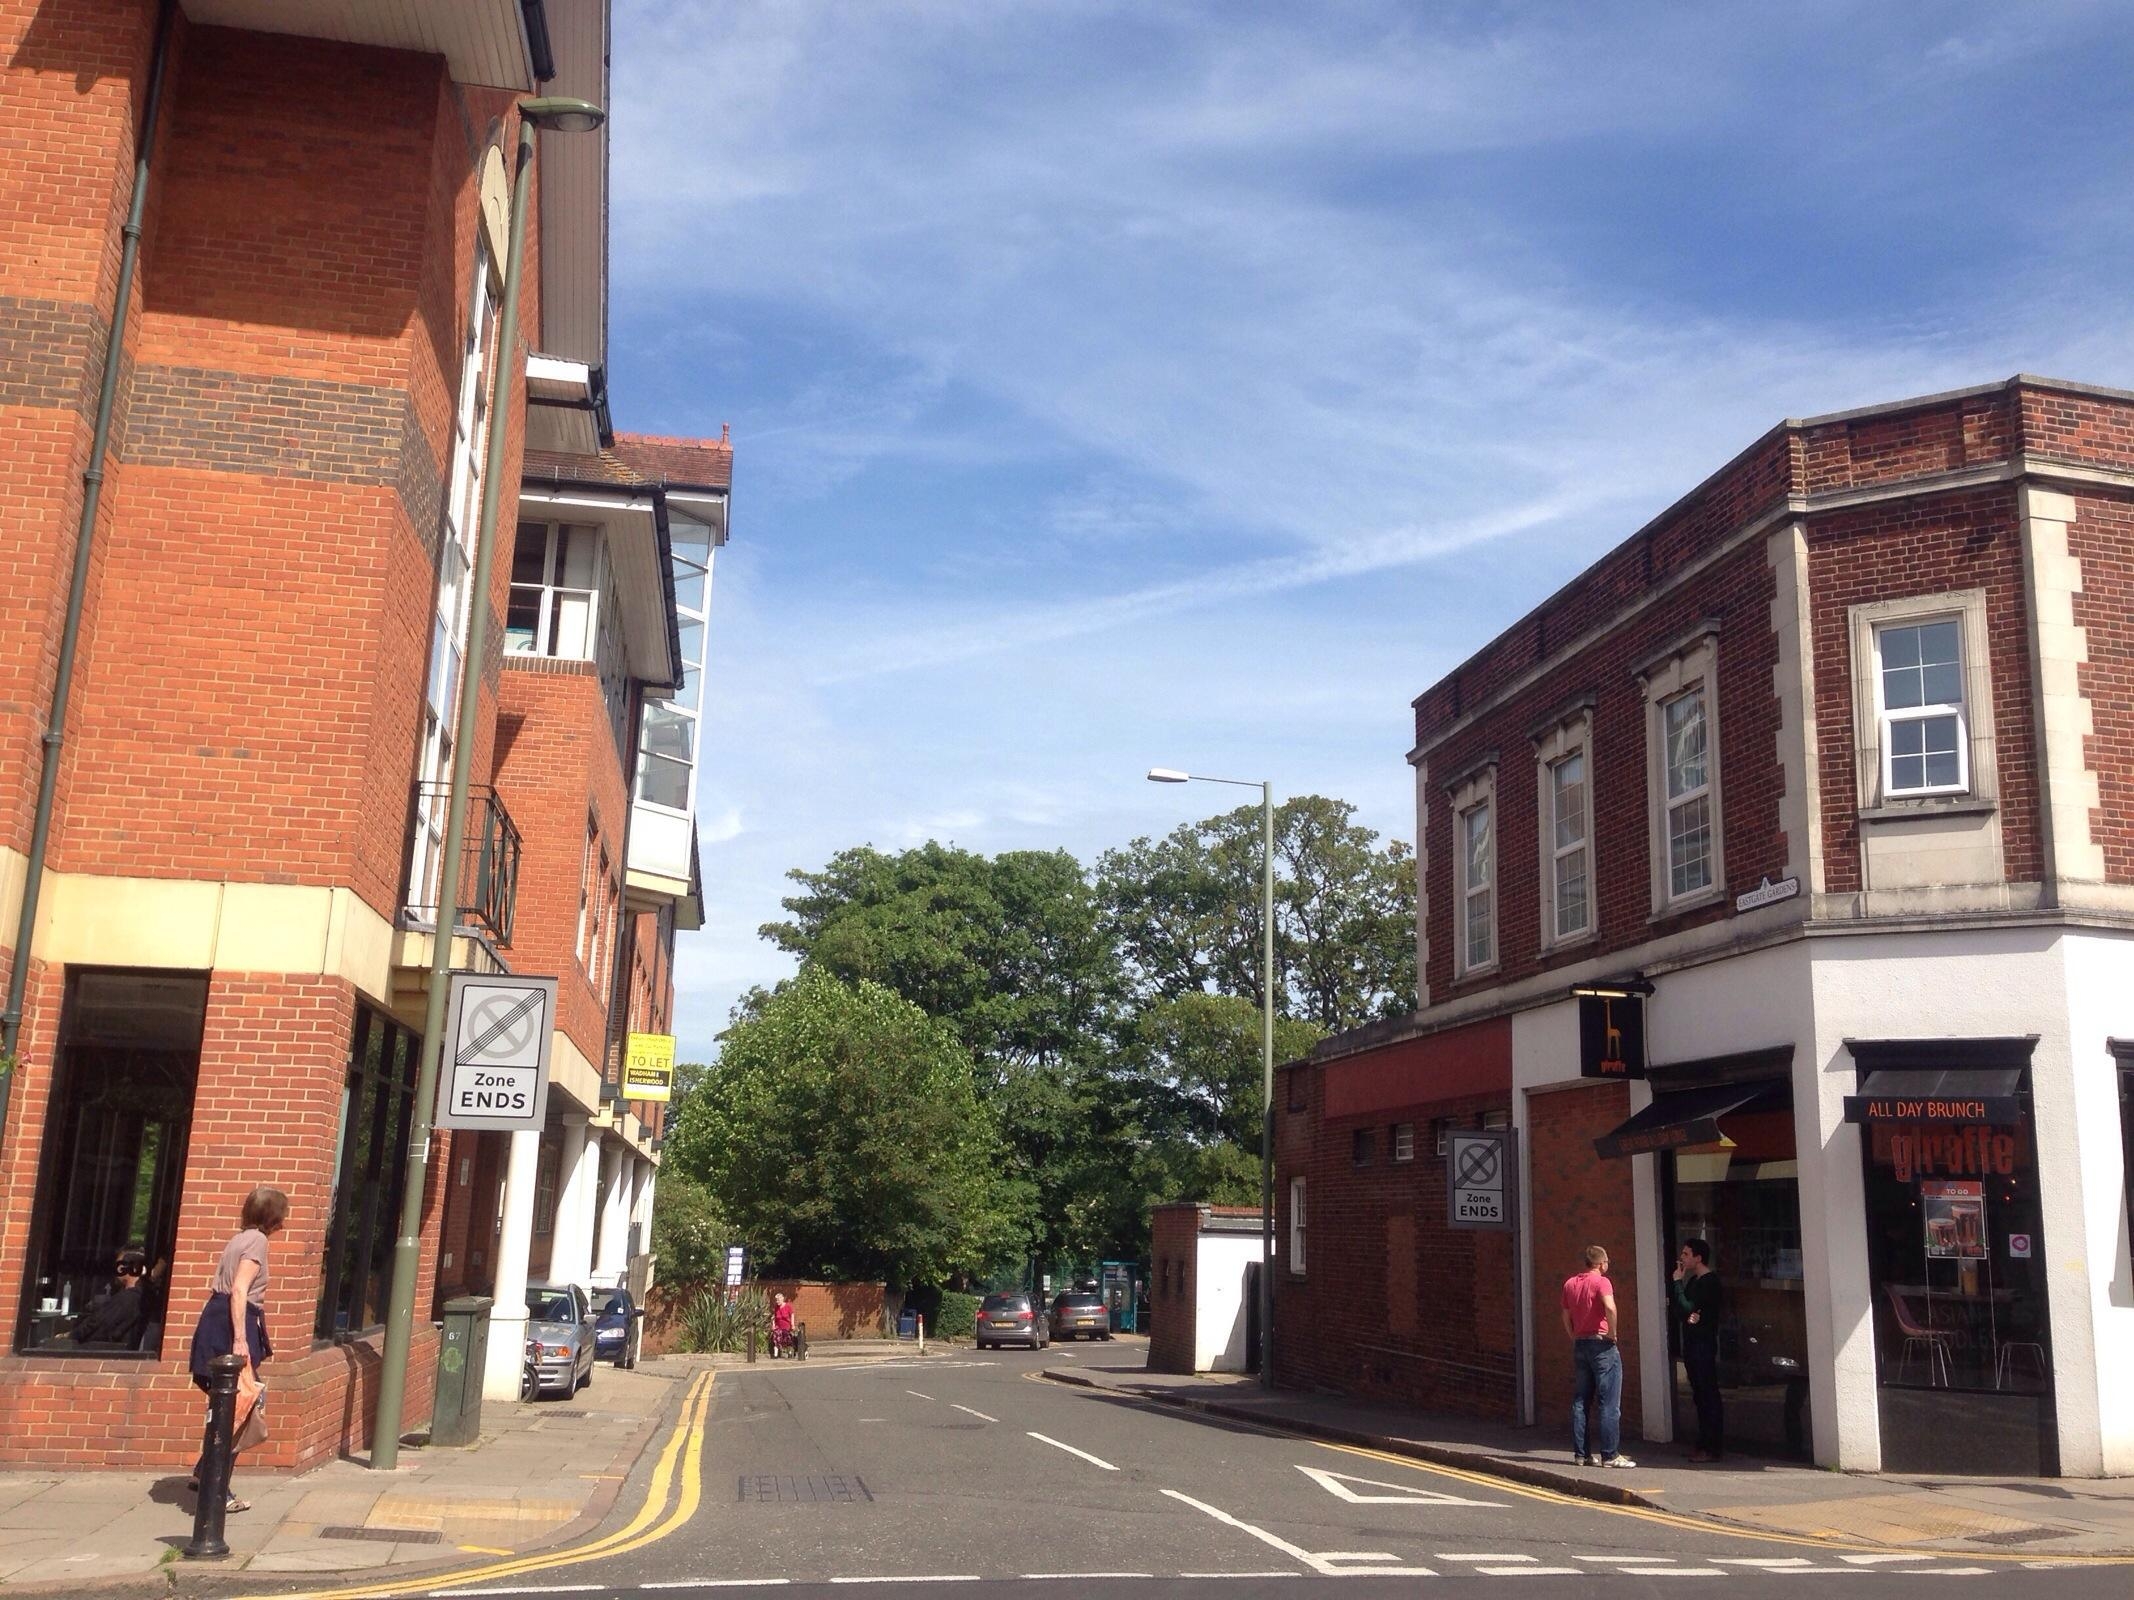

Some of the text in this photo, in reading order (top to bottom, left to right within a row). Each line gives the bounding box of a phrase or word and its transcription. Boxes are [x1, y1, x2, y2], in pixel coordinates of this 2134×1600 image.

[631, 1055, 671, 1068] TO LET
[474, 1072, 516, 1087] Zone
[461, 1091, 526, 1110] ENDS
[1868, 1102, 1985, 1118] ALL DAY BRUNCH
[1890, 1124, 2015, 1183] giraffe
[1466, 1193, 1491, 1203] Zone
[1460, 1205, 1498, 1217] ENDS
